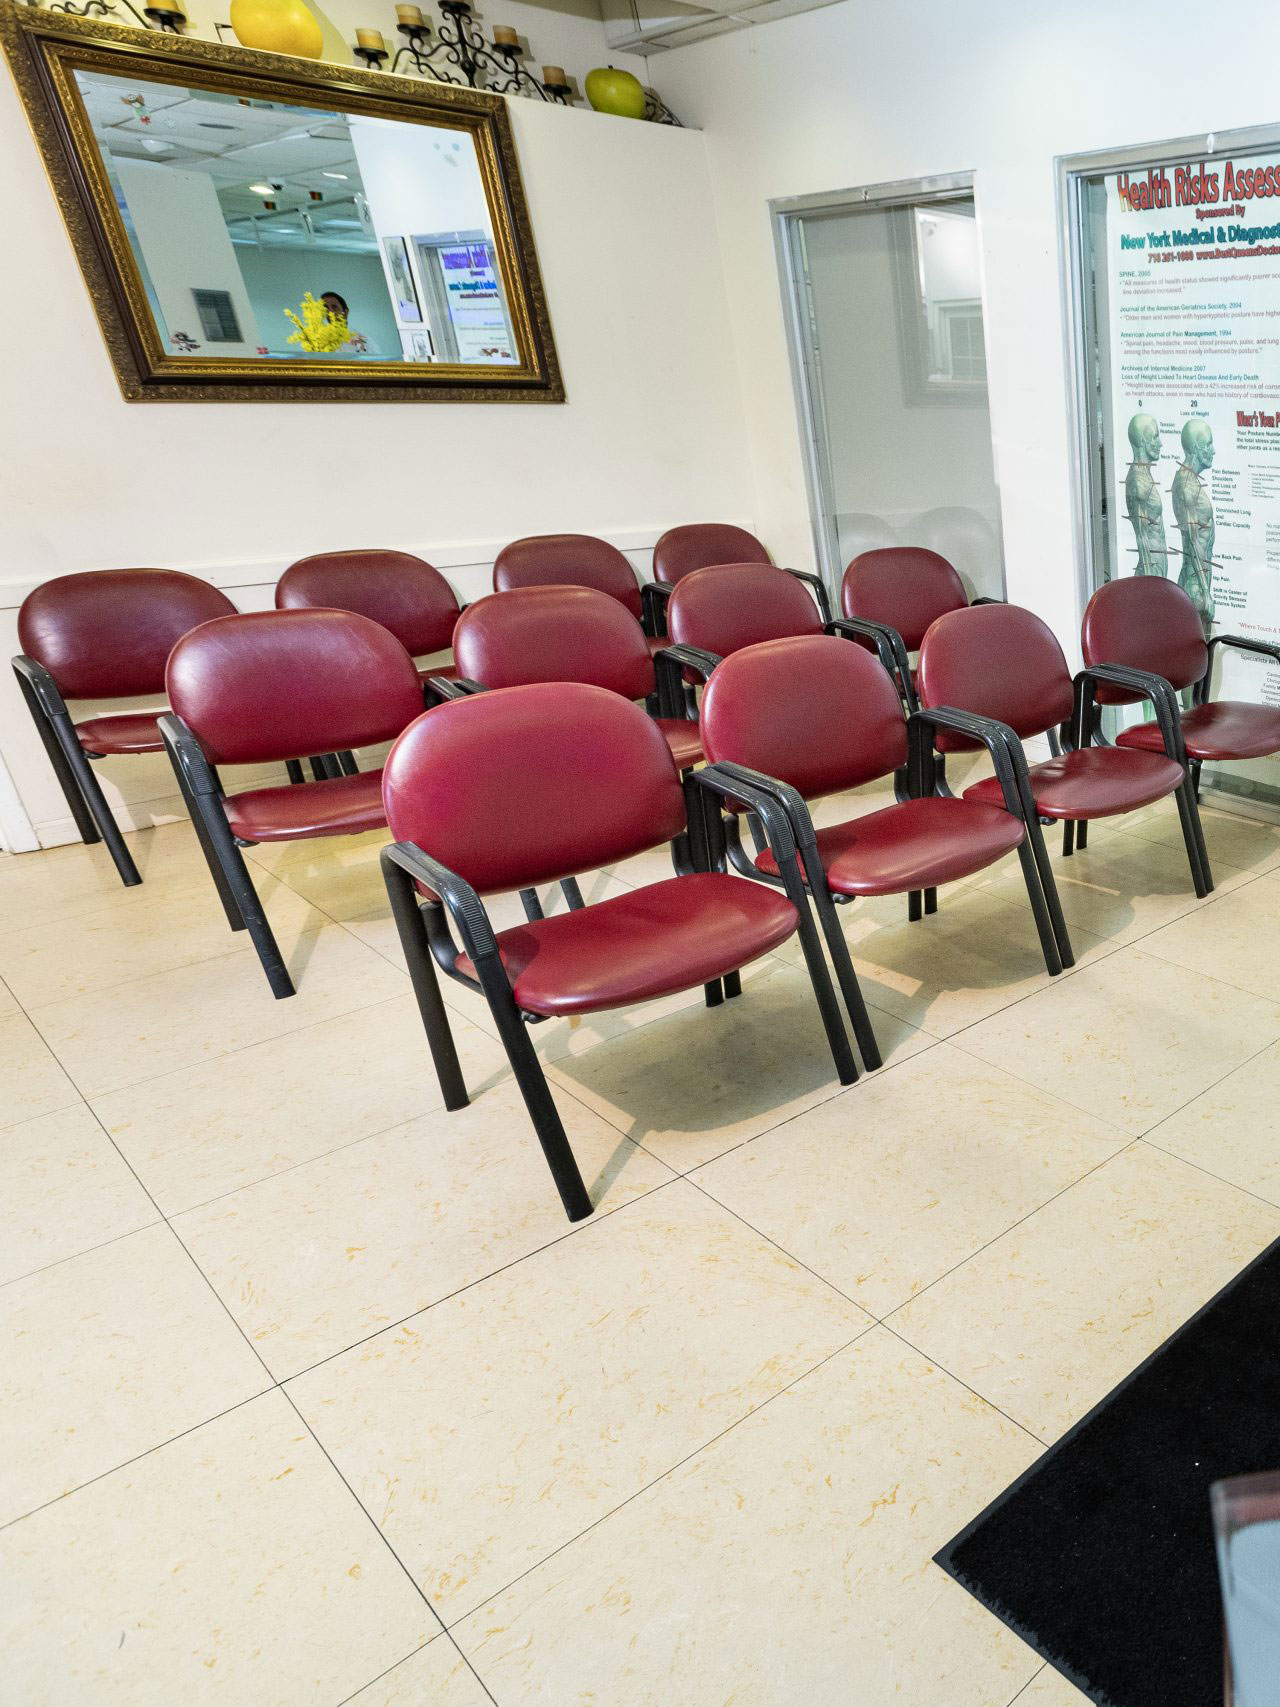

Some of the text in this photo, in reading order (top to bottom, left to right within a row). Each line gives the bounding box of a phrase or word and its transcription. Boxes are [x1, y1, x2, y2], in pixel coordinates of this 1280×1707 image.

[1117, 166, 1172, 212] Health
[1174, 162, 1219, 206] Risks
[1195, 204, 1245, 221] Sponsored By
[1121, 234, 1145, 250] New
[1147, 230, 1171, 247] York
[1172, 226, 1214, 246] Medical
[1217, 226, 1227, 242] &
[1252, 273, 1270, 281] poorer
[1267, 338, 1279, 346] lung
[1231, 347, 1238, 355] by
[1138, 400, 1143, 408] 0
[1190, 400, 1198, 408] 20
[1232, 522, 1251, 530] Capacity
[1257, 625, 1273, 633] Touch
